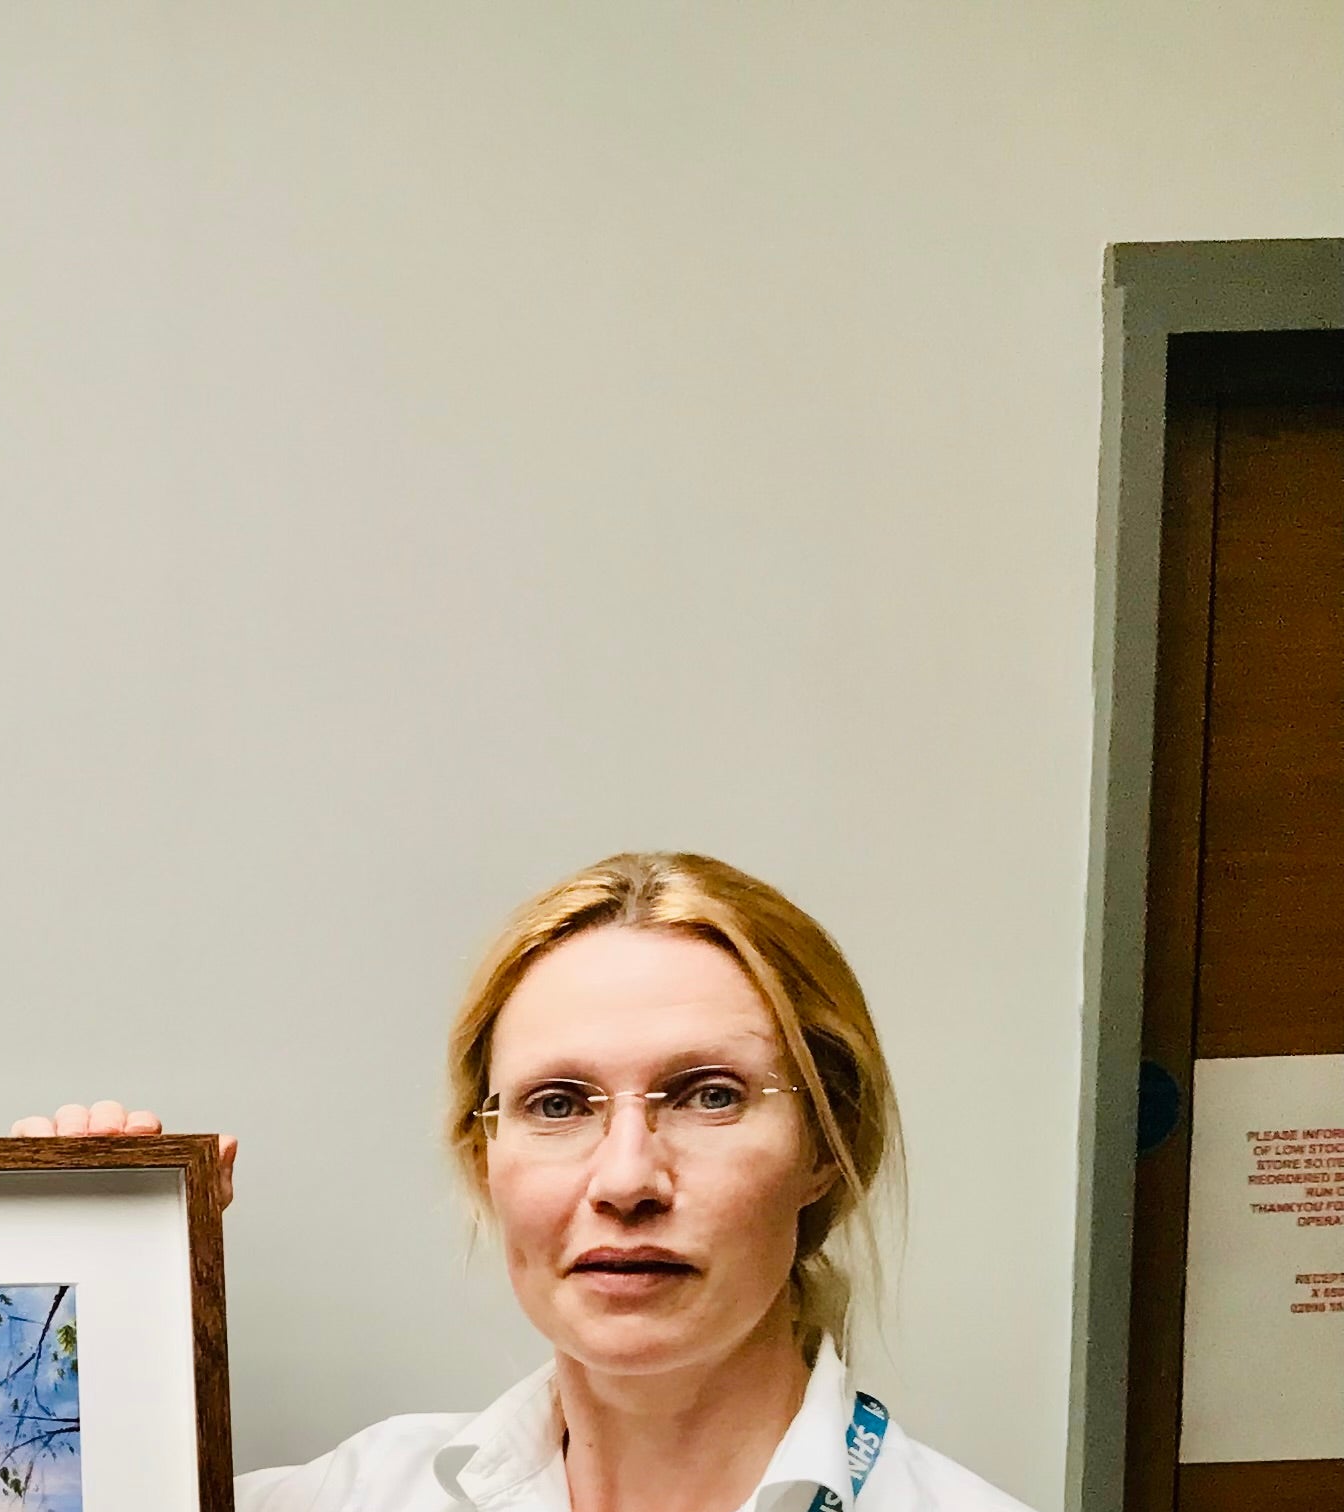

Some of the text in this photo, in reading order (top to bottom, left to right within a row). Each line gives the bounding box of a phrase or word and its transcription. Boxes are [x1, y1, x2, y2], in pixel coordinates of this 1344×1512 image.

[1246, 1130, 1298, 1141] PLEASE
[1253, 1146, 1272, 1155] OF
[1275, 1144, 1305, 1155] LOW
[1256, 1159, 1301, 1170] STORE
[1247, 1172, 1330, 1185] REORDERED
[1297, 1215, 1344, 1227] OPERA
[848, 1425, 880, 1480] NHS
